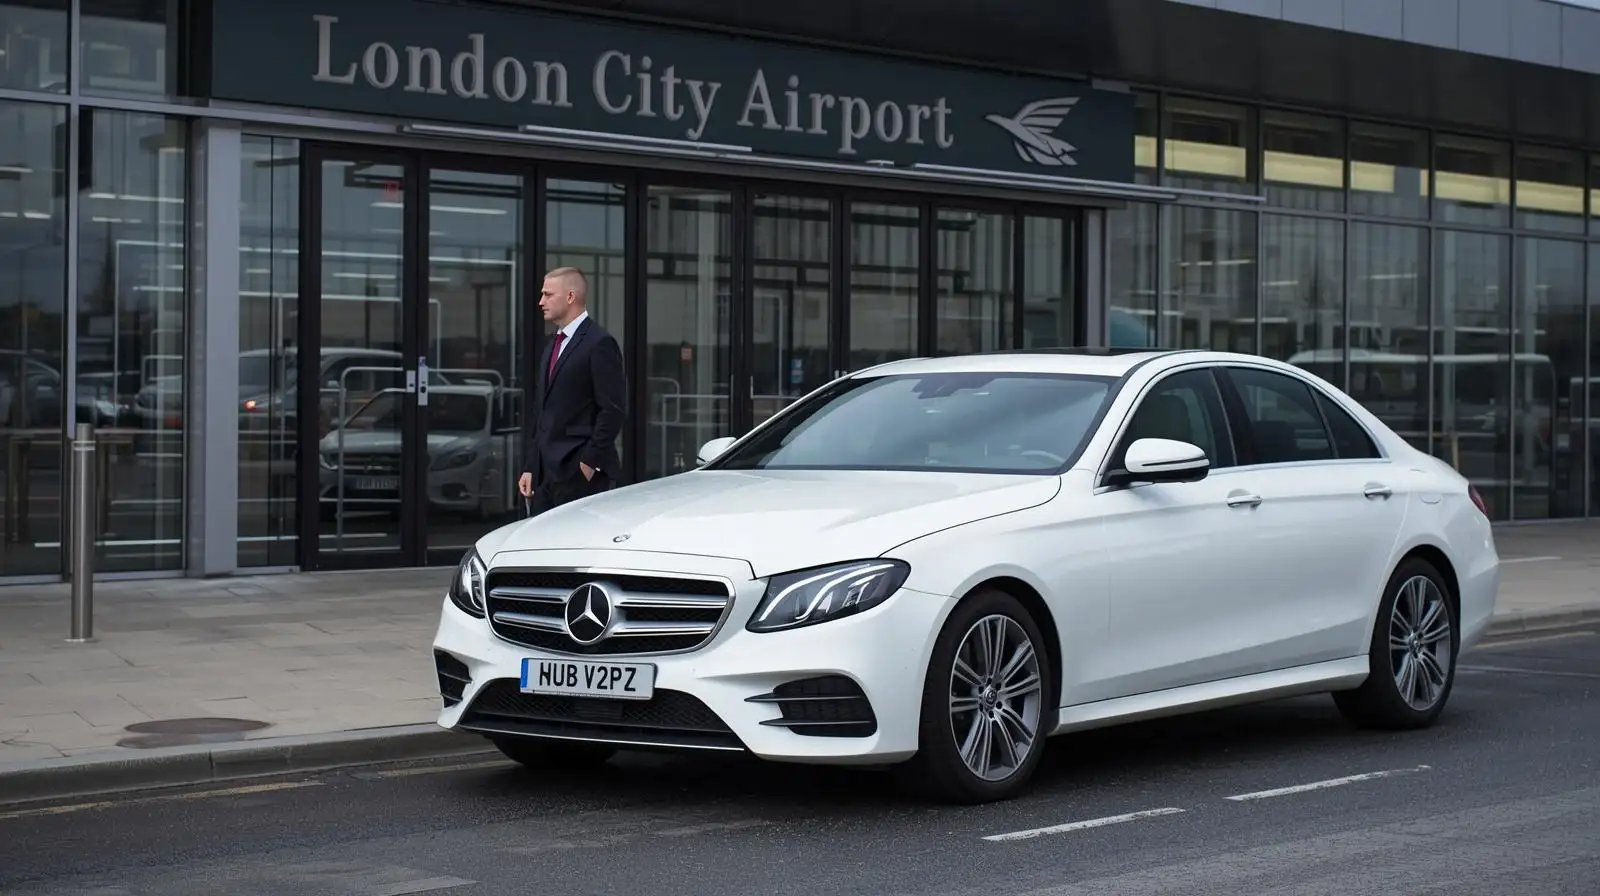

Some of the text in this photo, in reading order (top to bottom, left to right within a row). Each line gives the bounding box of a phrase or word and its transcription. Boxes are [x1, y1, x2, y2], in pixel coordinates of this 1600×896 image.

[312, 14, 954, 154] London City Airport
[584, 665, 636, 692] V2PZ
